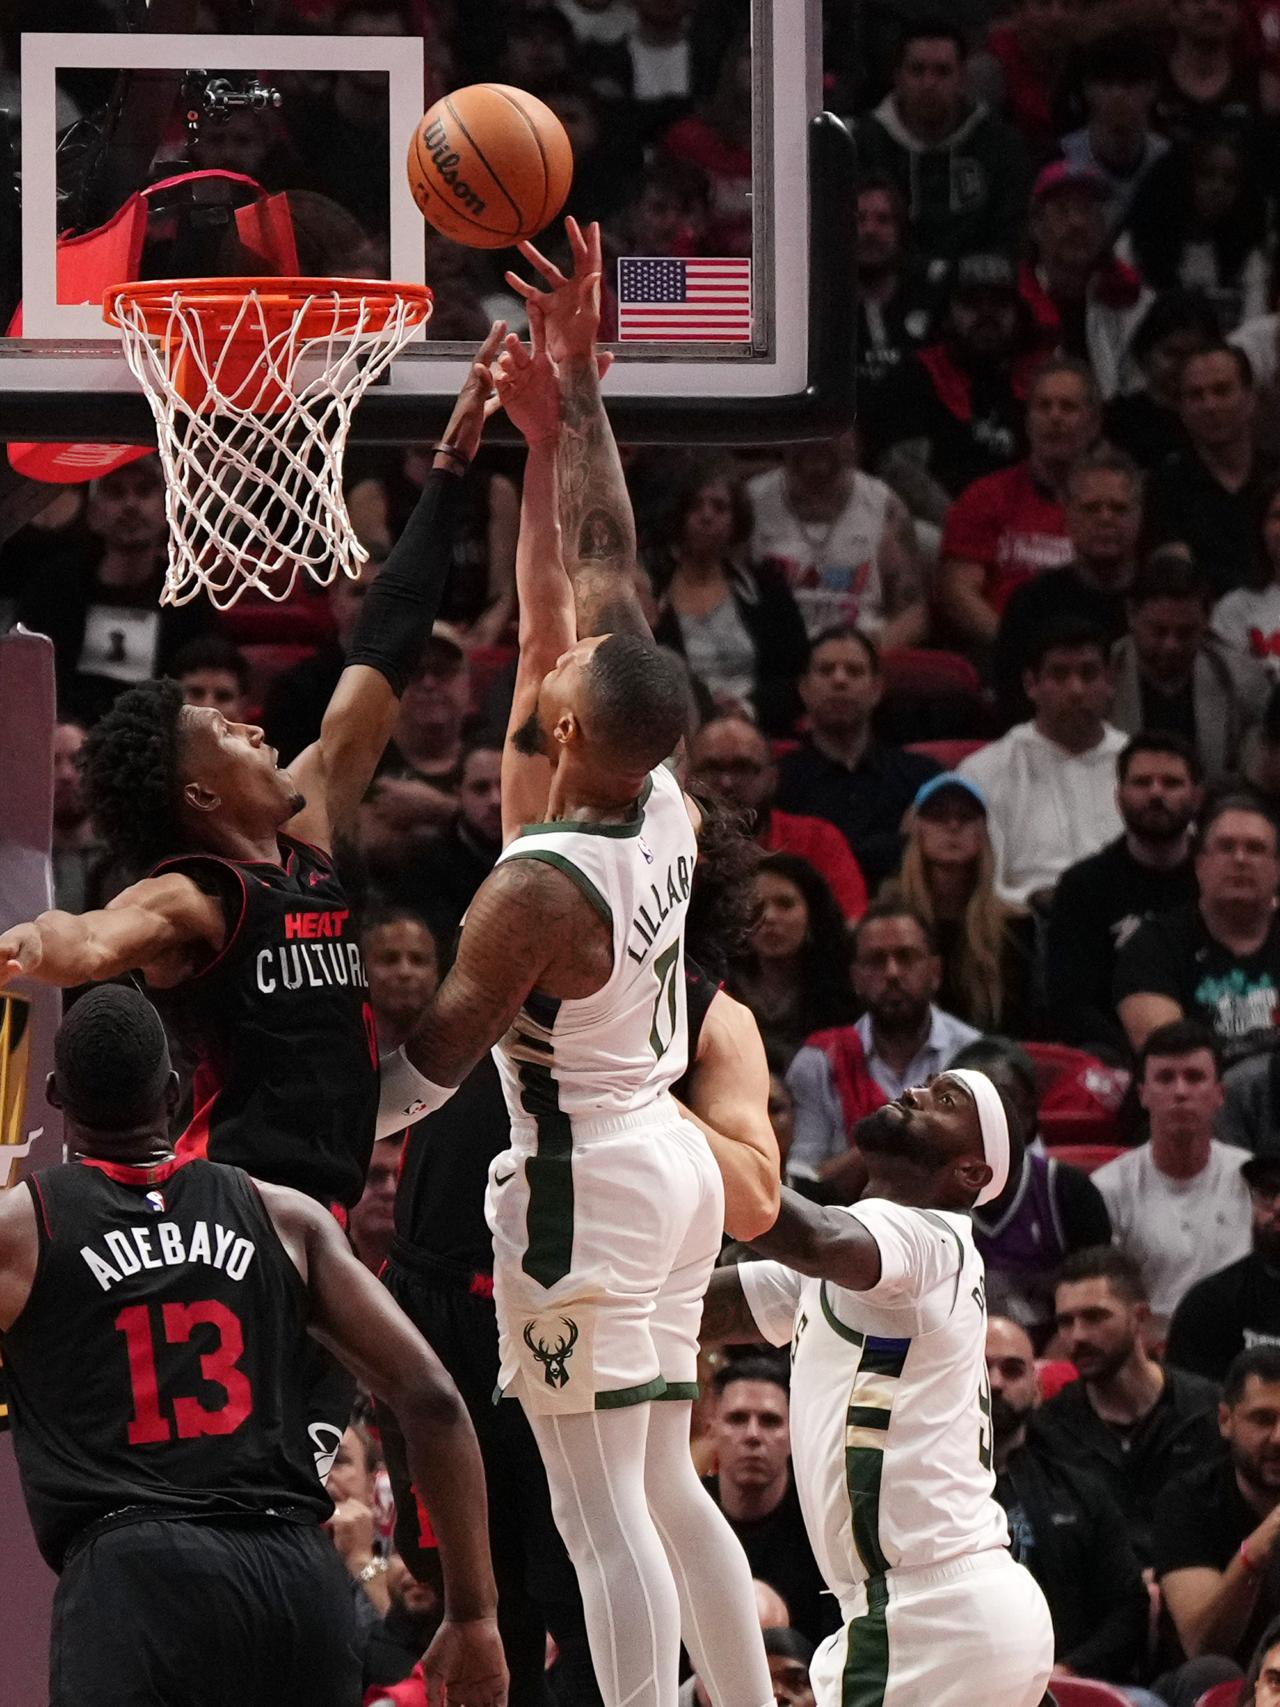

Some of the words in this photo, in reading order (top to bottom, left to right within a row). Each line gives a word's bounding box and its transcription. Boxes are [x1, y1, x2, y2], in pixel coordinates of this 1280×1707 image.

[423, 116, 487, 217] Wilson
[284, 910, 351, 940] HEAT
[627, 855, 694, 966] LILLAR
[648, 935, 680, 1062] 0
[80, 1220, 256, 1292] ADEBAYO
[114, 1299, 254, 1445] 13
